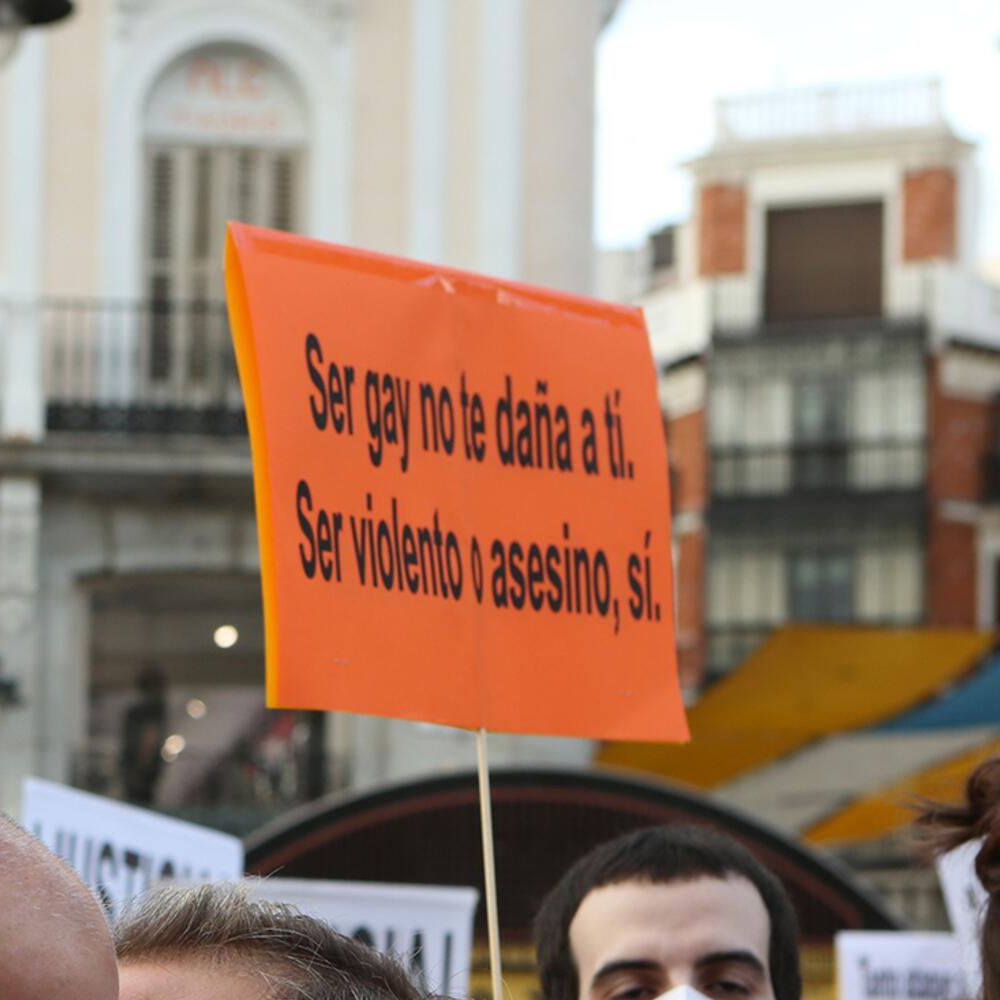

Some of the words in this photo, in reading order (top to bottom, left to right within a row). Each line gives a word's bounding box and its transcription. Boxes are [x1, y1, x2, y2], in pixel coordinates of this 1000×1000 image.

[305, 333, 355, 435] Ser
[364, 370, 411, 473] gay
[419, 382, 456, 456] no
[459, 371, 487, 463] te
[495, 375, 573, 472] daña
[581, 408, 600, 475] a
[295, 479, 343, 582] Ser
[349, 493, 464, 601] violento
[470, 535, 484, 605] o
[490, 522, 621, 634] asesino,
[627, 530, 661, 621] sí.
